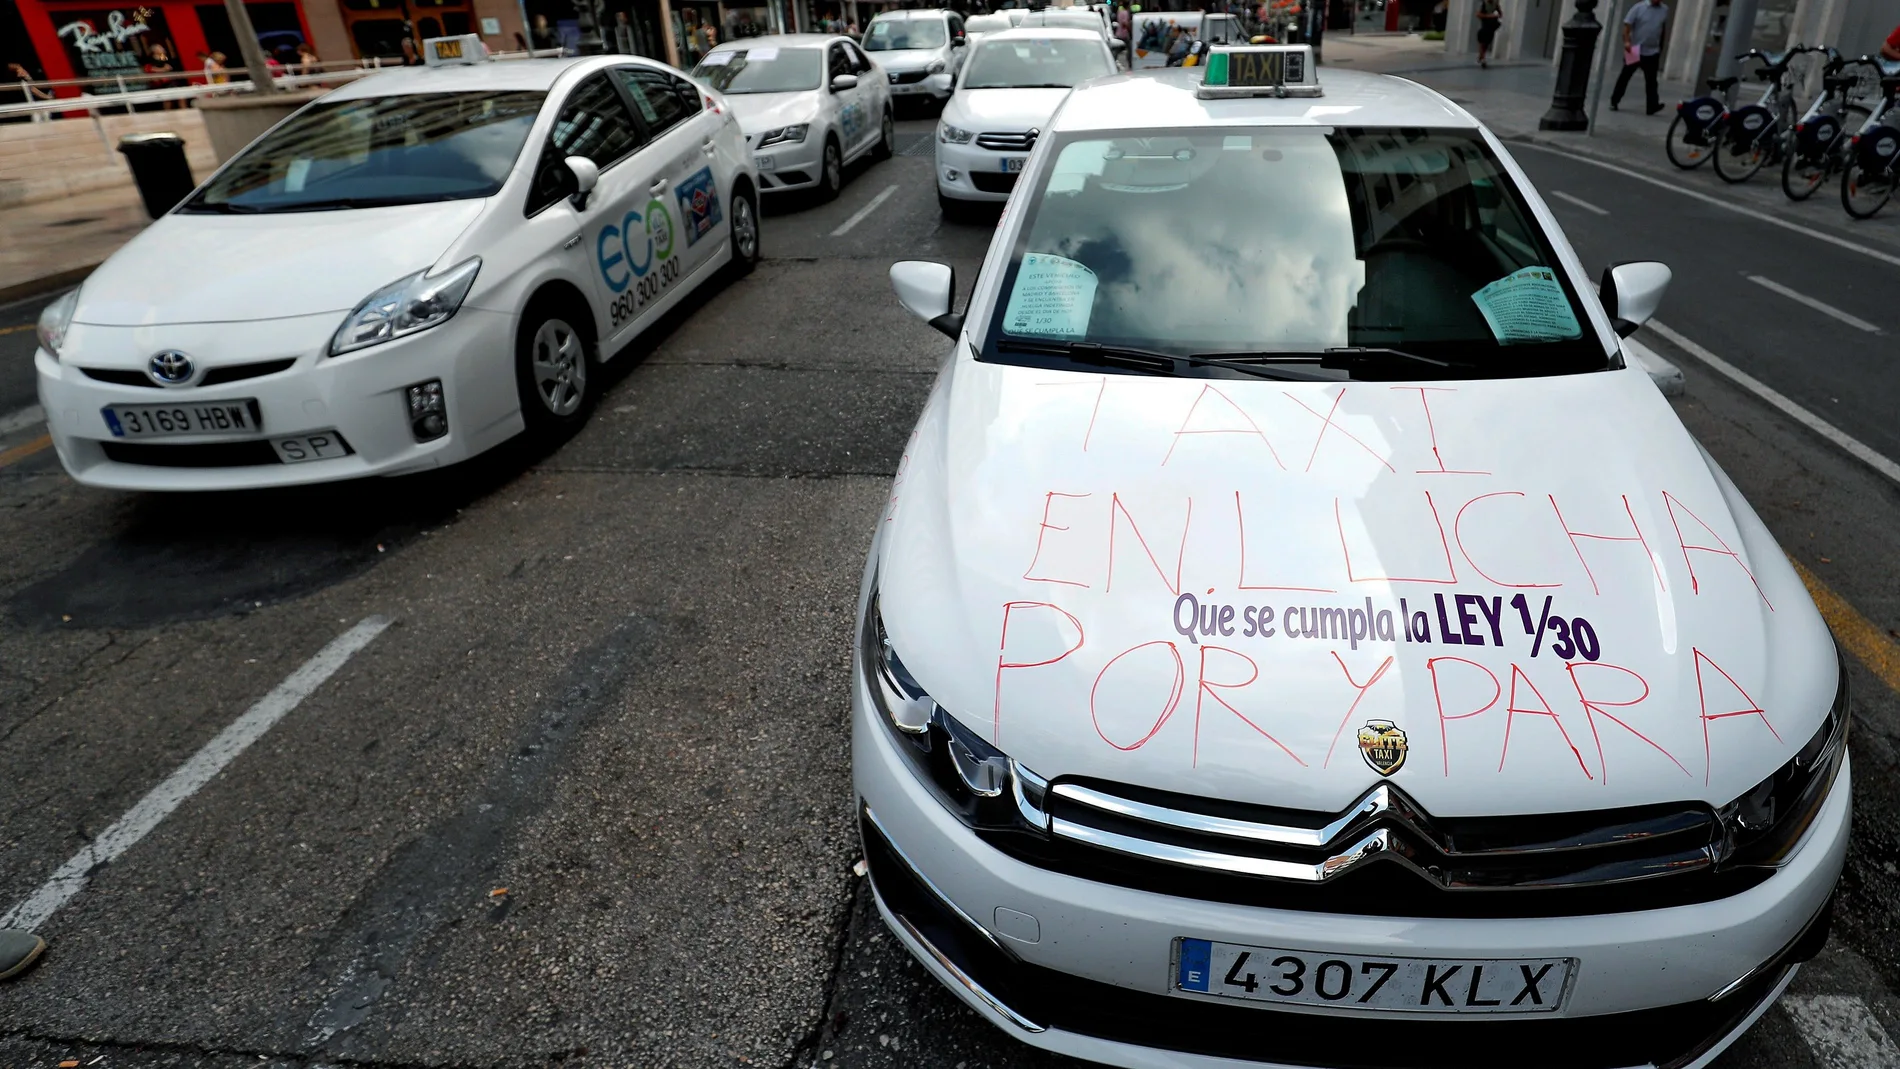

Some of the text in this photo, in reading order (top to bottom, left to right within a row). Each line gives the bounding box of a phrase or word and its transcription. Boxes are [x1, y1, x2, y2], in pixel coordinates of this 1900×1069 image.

[435, 40, 462, 58] TAXI
[1233, 53, 1280, 81] TAXI
[610, 255, 679, 327] 960 300 300
[124, 405, 246, 433] 3169 HBW
[1035, 377, 1492, 475] TAXI
[1173, 592, 1601, 662] Que se cumpla la LEY 1/30
[993, 600, 1785, 788] POR Y PARA
[1373, 748, 1393, 760] TAXI
[1223, 951, 1555, 1007] 4307 KLX
